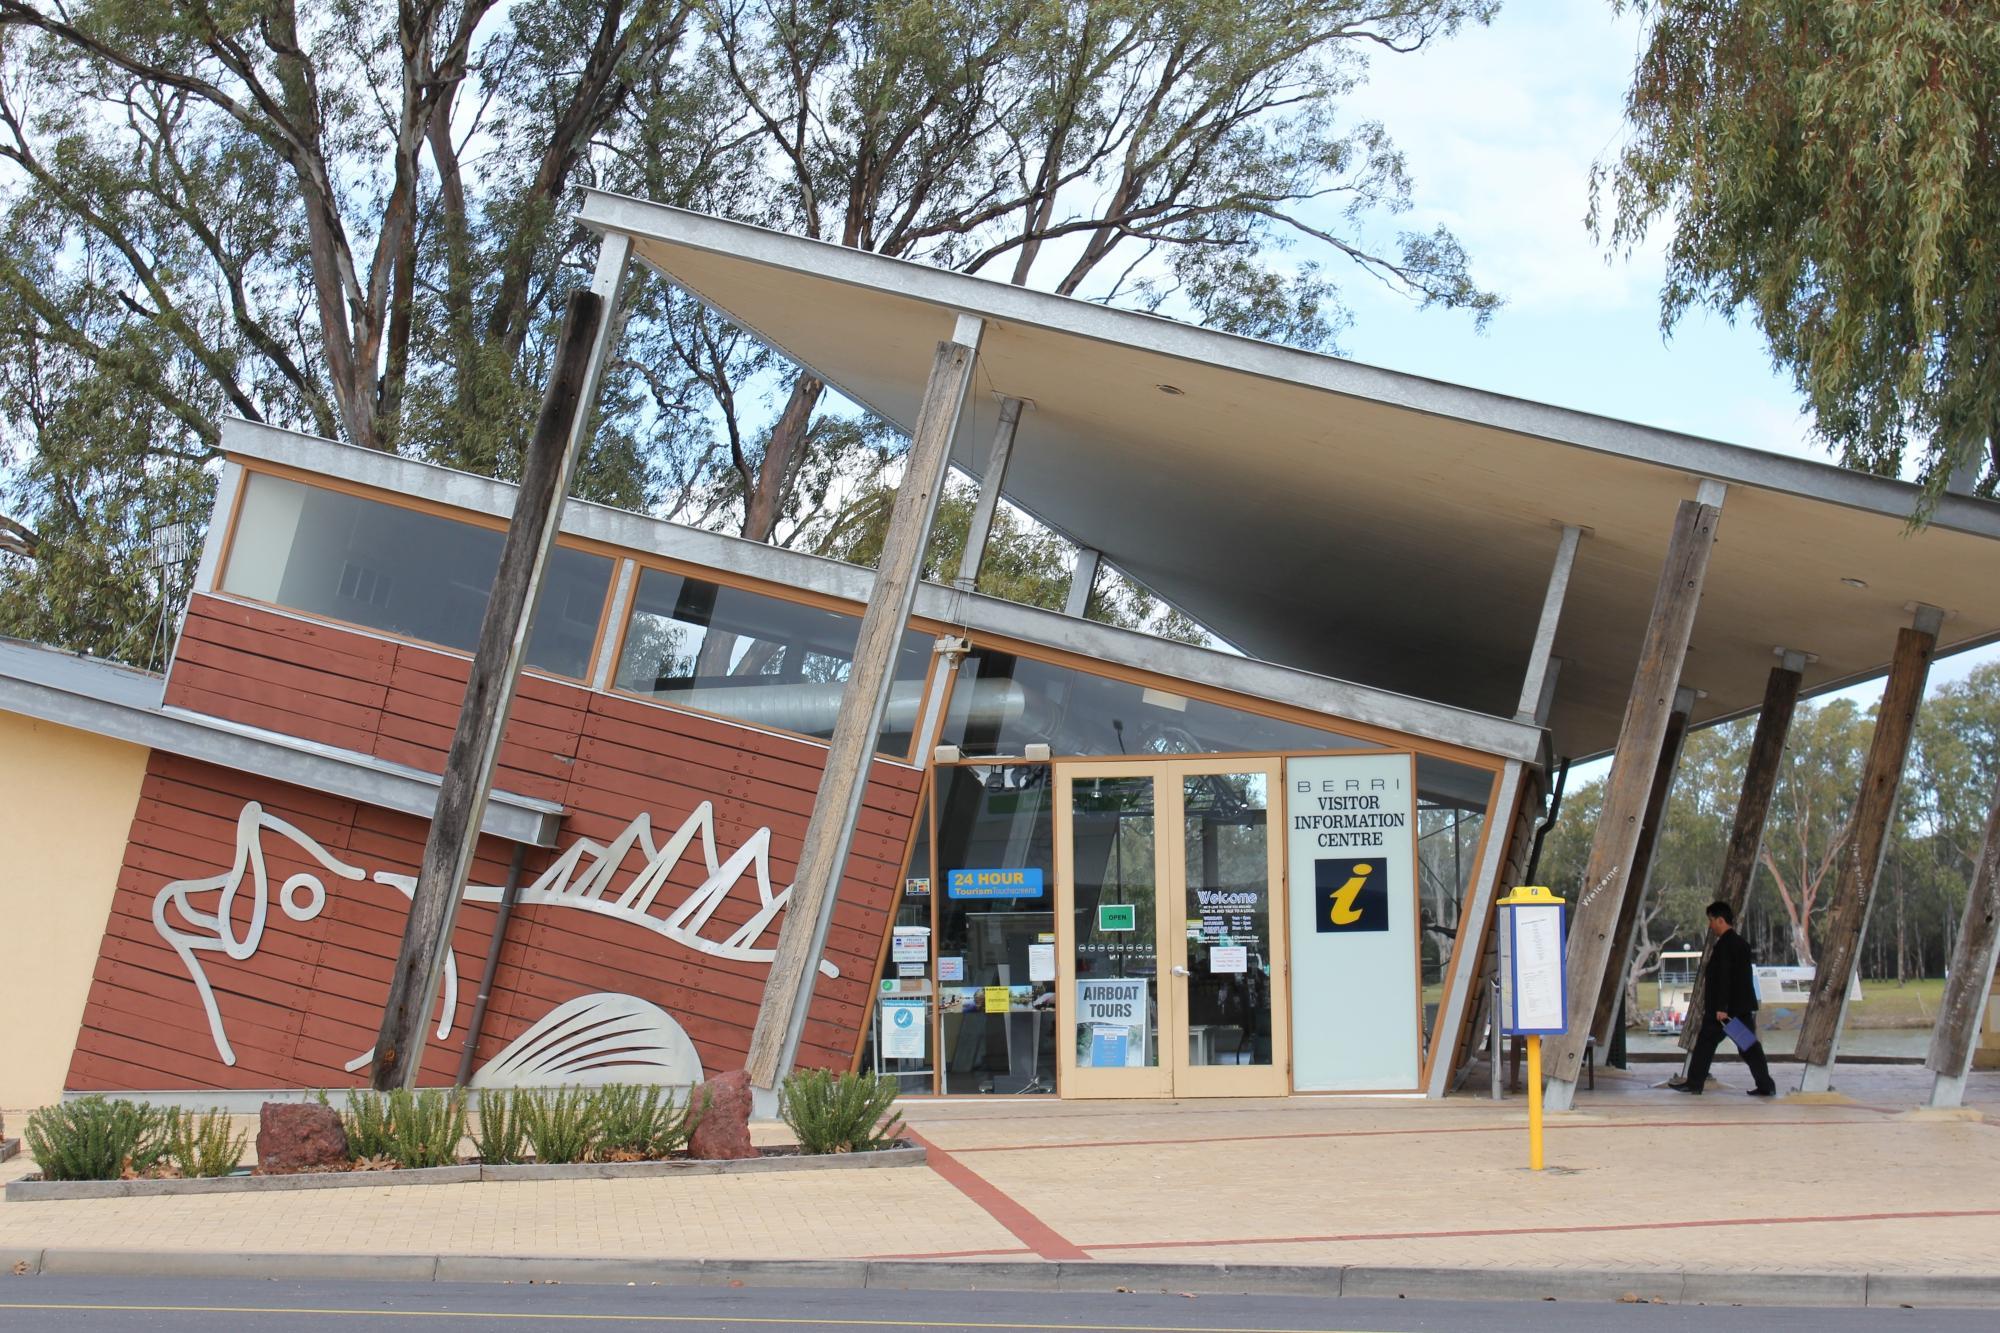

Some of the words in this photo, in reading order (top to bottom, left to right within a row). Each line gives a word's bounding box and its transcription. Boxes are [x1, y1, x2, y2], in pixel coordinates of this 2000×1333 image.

[1297, 778, 1400, 793] BERRI
[1318, 795, 1380, 811] VISITOR
[1294, 813, 1405, 830] INFORMATION
[1317, 832, 1383, 847] CENTRE
[954, 873, 973, 886] 24
[978, 872, 1024, 885] HOUR
[1582, 866, 1619, 906] Welcome
[1197, 890, 1258, 904] Welcome
[1108, 913, 1127, 921] OPEN
[1083, 986, 1139, 1001] AIRBOAT
[1089, 1003, 1132, 1018] TOURS
